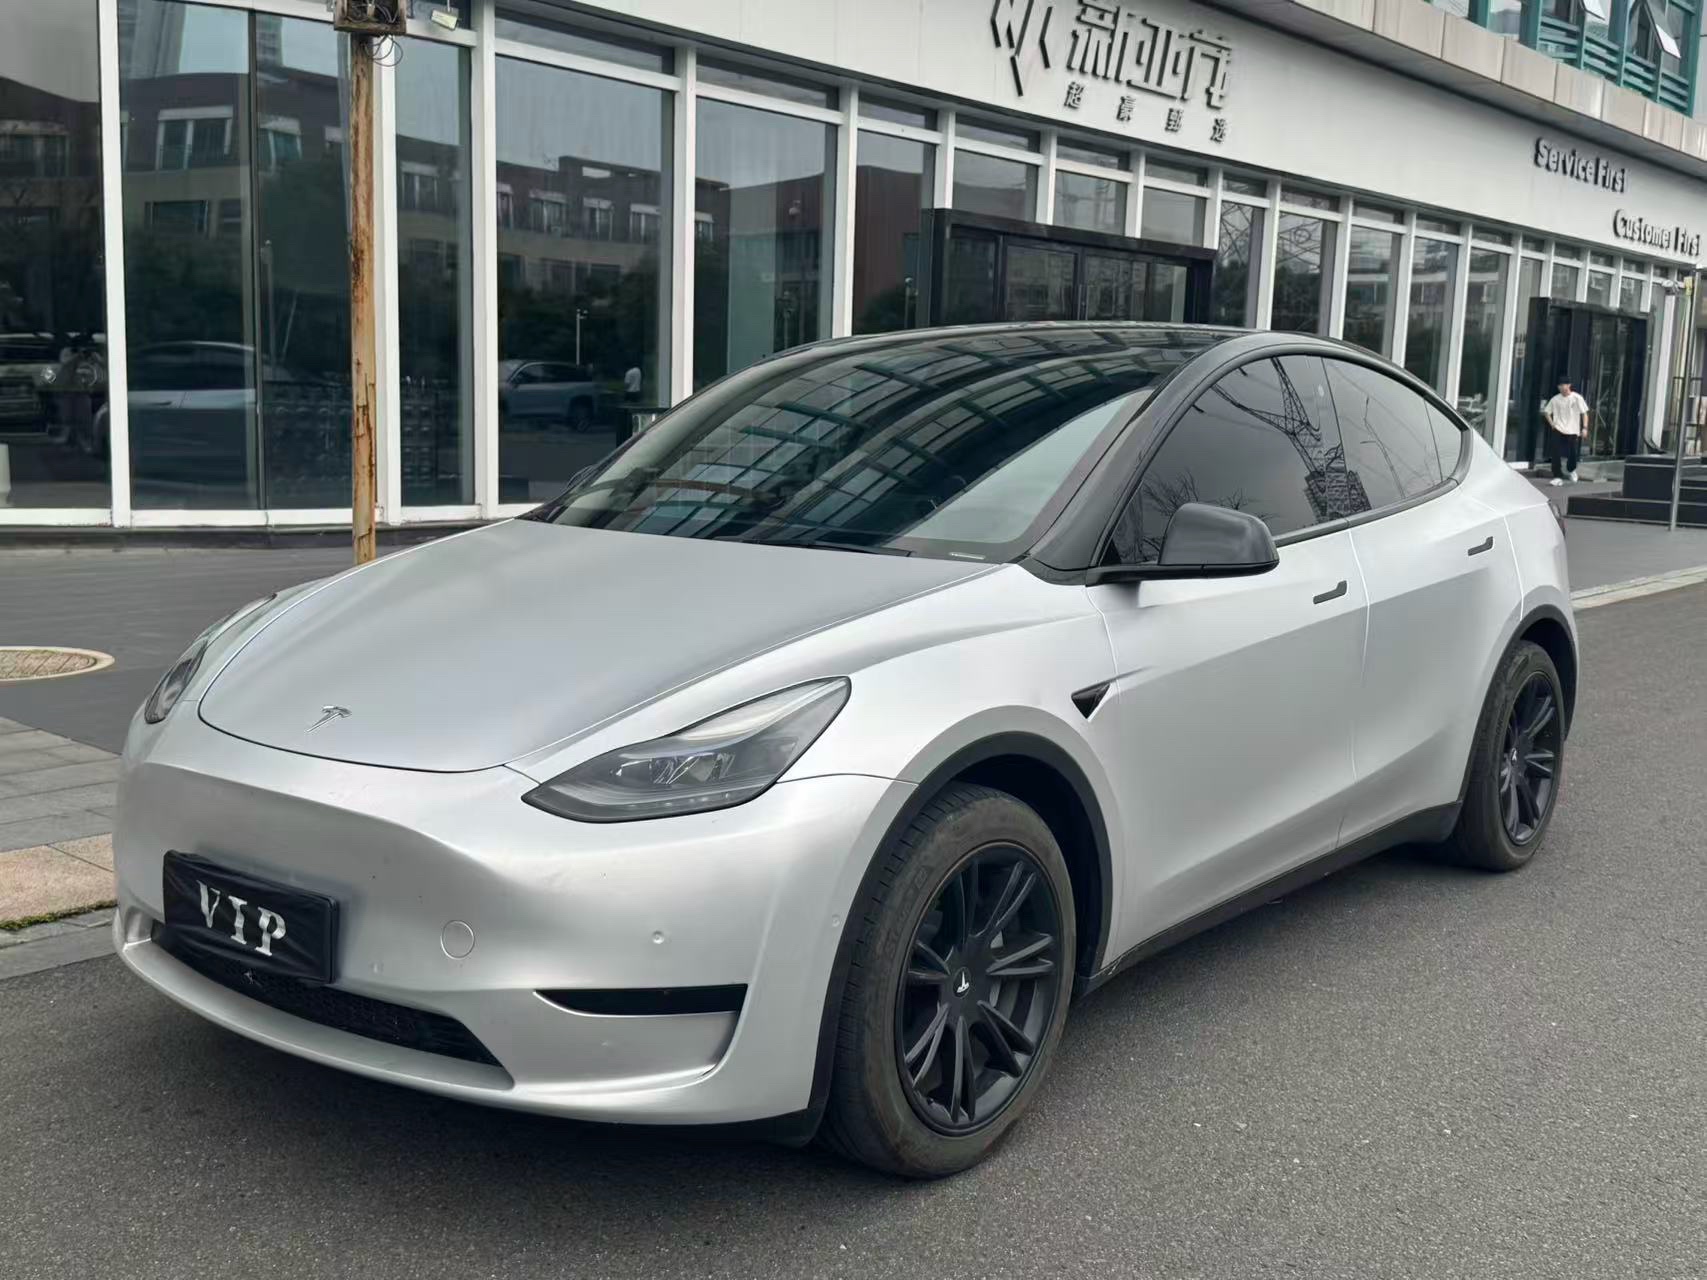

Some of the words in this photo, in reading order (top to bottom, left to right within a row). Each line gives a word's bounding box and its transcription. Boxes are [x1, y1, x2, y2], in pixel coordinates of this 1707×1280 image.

[1534, 136, 1594, 183] Service
[1593, 156, 1628, 193] First
[1674, 226, 1702, 257] First
[196, 879, 287, 957] VIP
